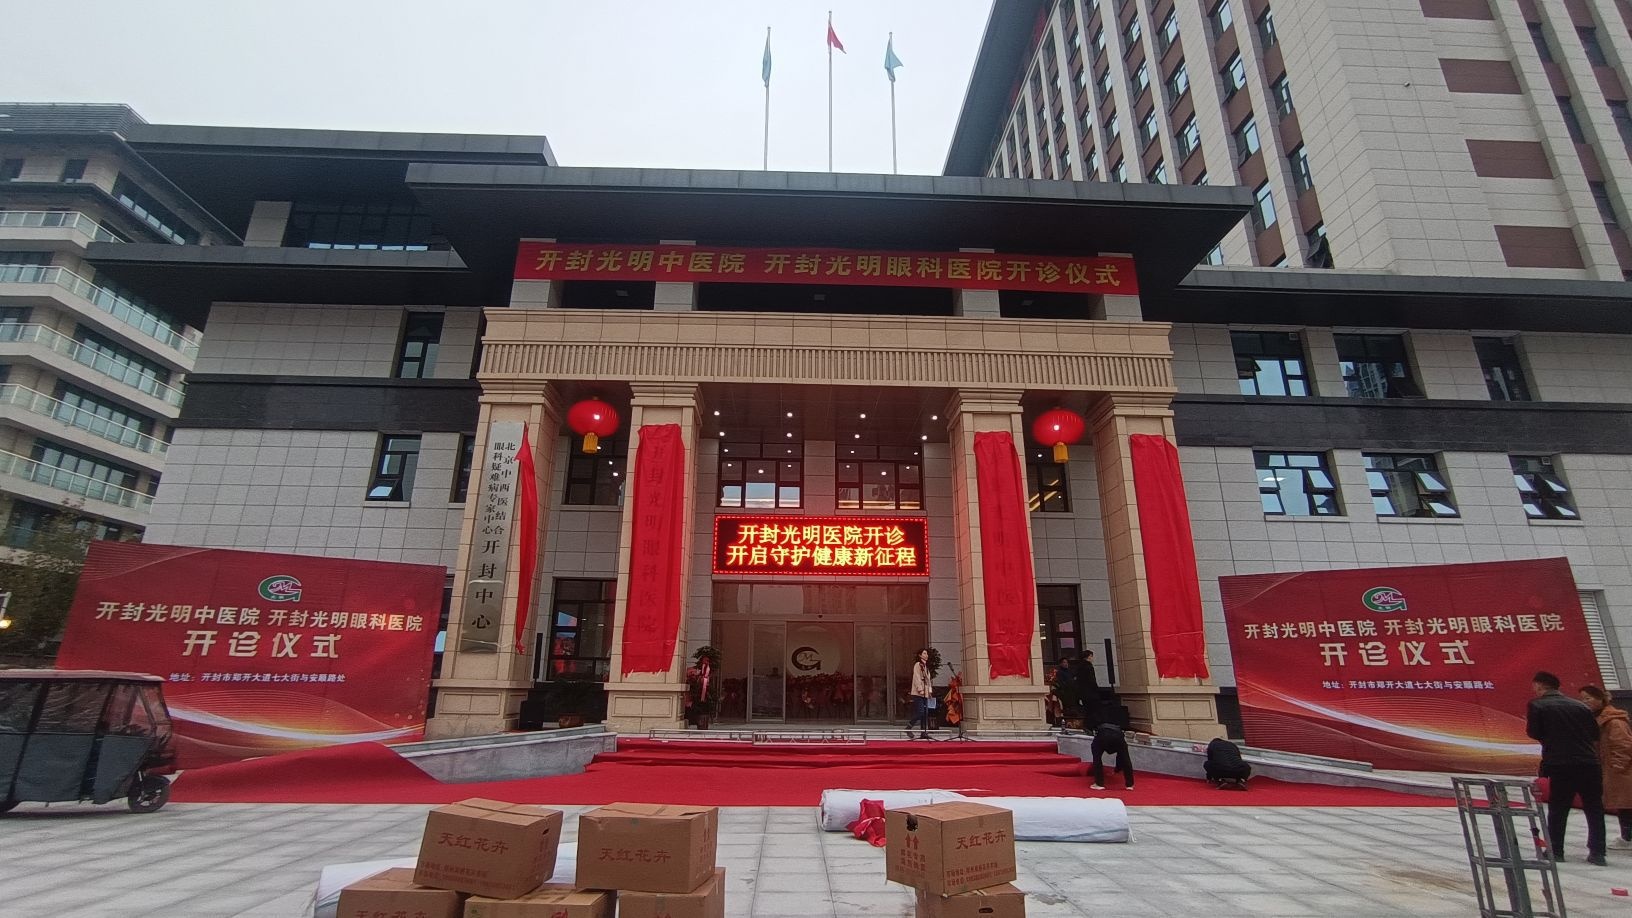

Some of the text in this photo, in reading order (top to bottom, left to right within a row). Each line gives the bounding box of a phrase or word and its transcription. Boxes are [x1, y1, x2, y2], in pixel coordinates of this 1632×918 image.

[535, 249, 1121, 287] 开封光明中医院 开封光明眼科医院开诊仪式
[481, 442, 505, 535] 眼科疑难病专家中心
[493, 442, 516, 535] 北京中西医结合
[738, 524, 905, 546] 开封光明医院开诊
[726, 545, 917, 567] 开启守护健康新征程
[471, 539, 501, 630] 开封中心
[95, 601, 423, 632] 开封光明中医院 开封光明眼科医院
[1244, 612, 1565, 639] 开封光明中医院 开封光明眼科医院
[182, 629, 342, 659] 开诊仪式
[1319, 639, 1475, 667] 开诊仪式
[438, 832, 509, 855] 天红花卉
[956, 829, 1007, 850] 天红花卉
[599, 847, 672, 863] 天红花卉
